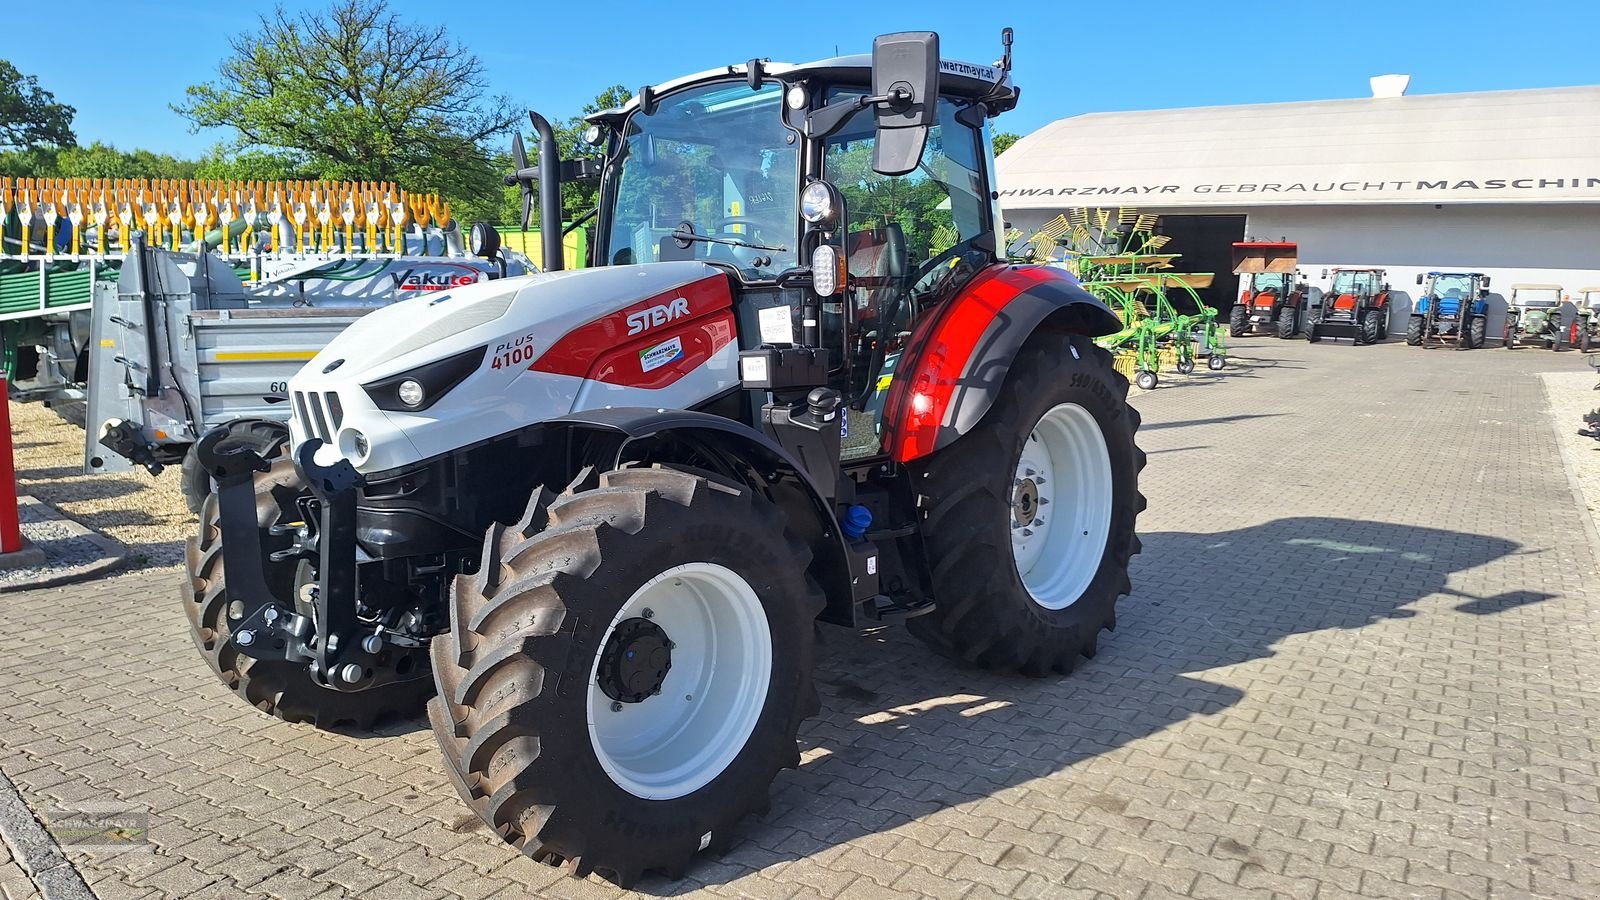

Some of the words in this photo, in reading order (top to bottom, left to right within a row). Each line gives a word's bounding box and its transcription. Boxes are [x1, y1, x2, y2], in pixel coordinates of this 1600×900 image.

[626, 297, 691, 336] STEYR
[495, 333, 534, 353] PLUS
[643, 344, 676, 361] SCHWARZMAYR
[491, 345, 534, 370] 4100
[270, 381, 287, 393] 60
